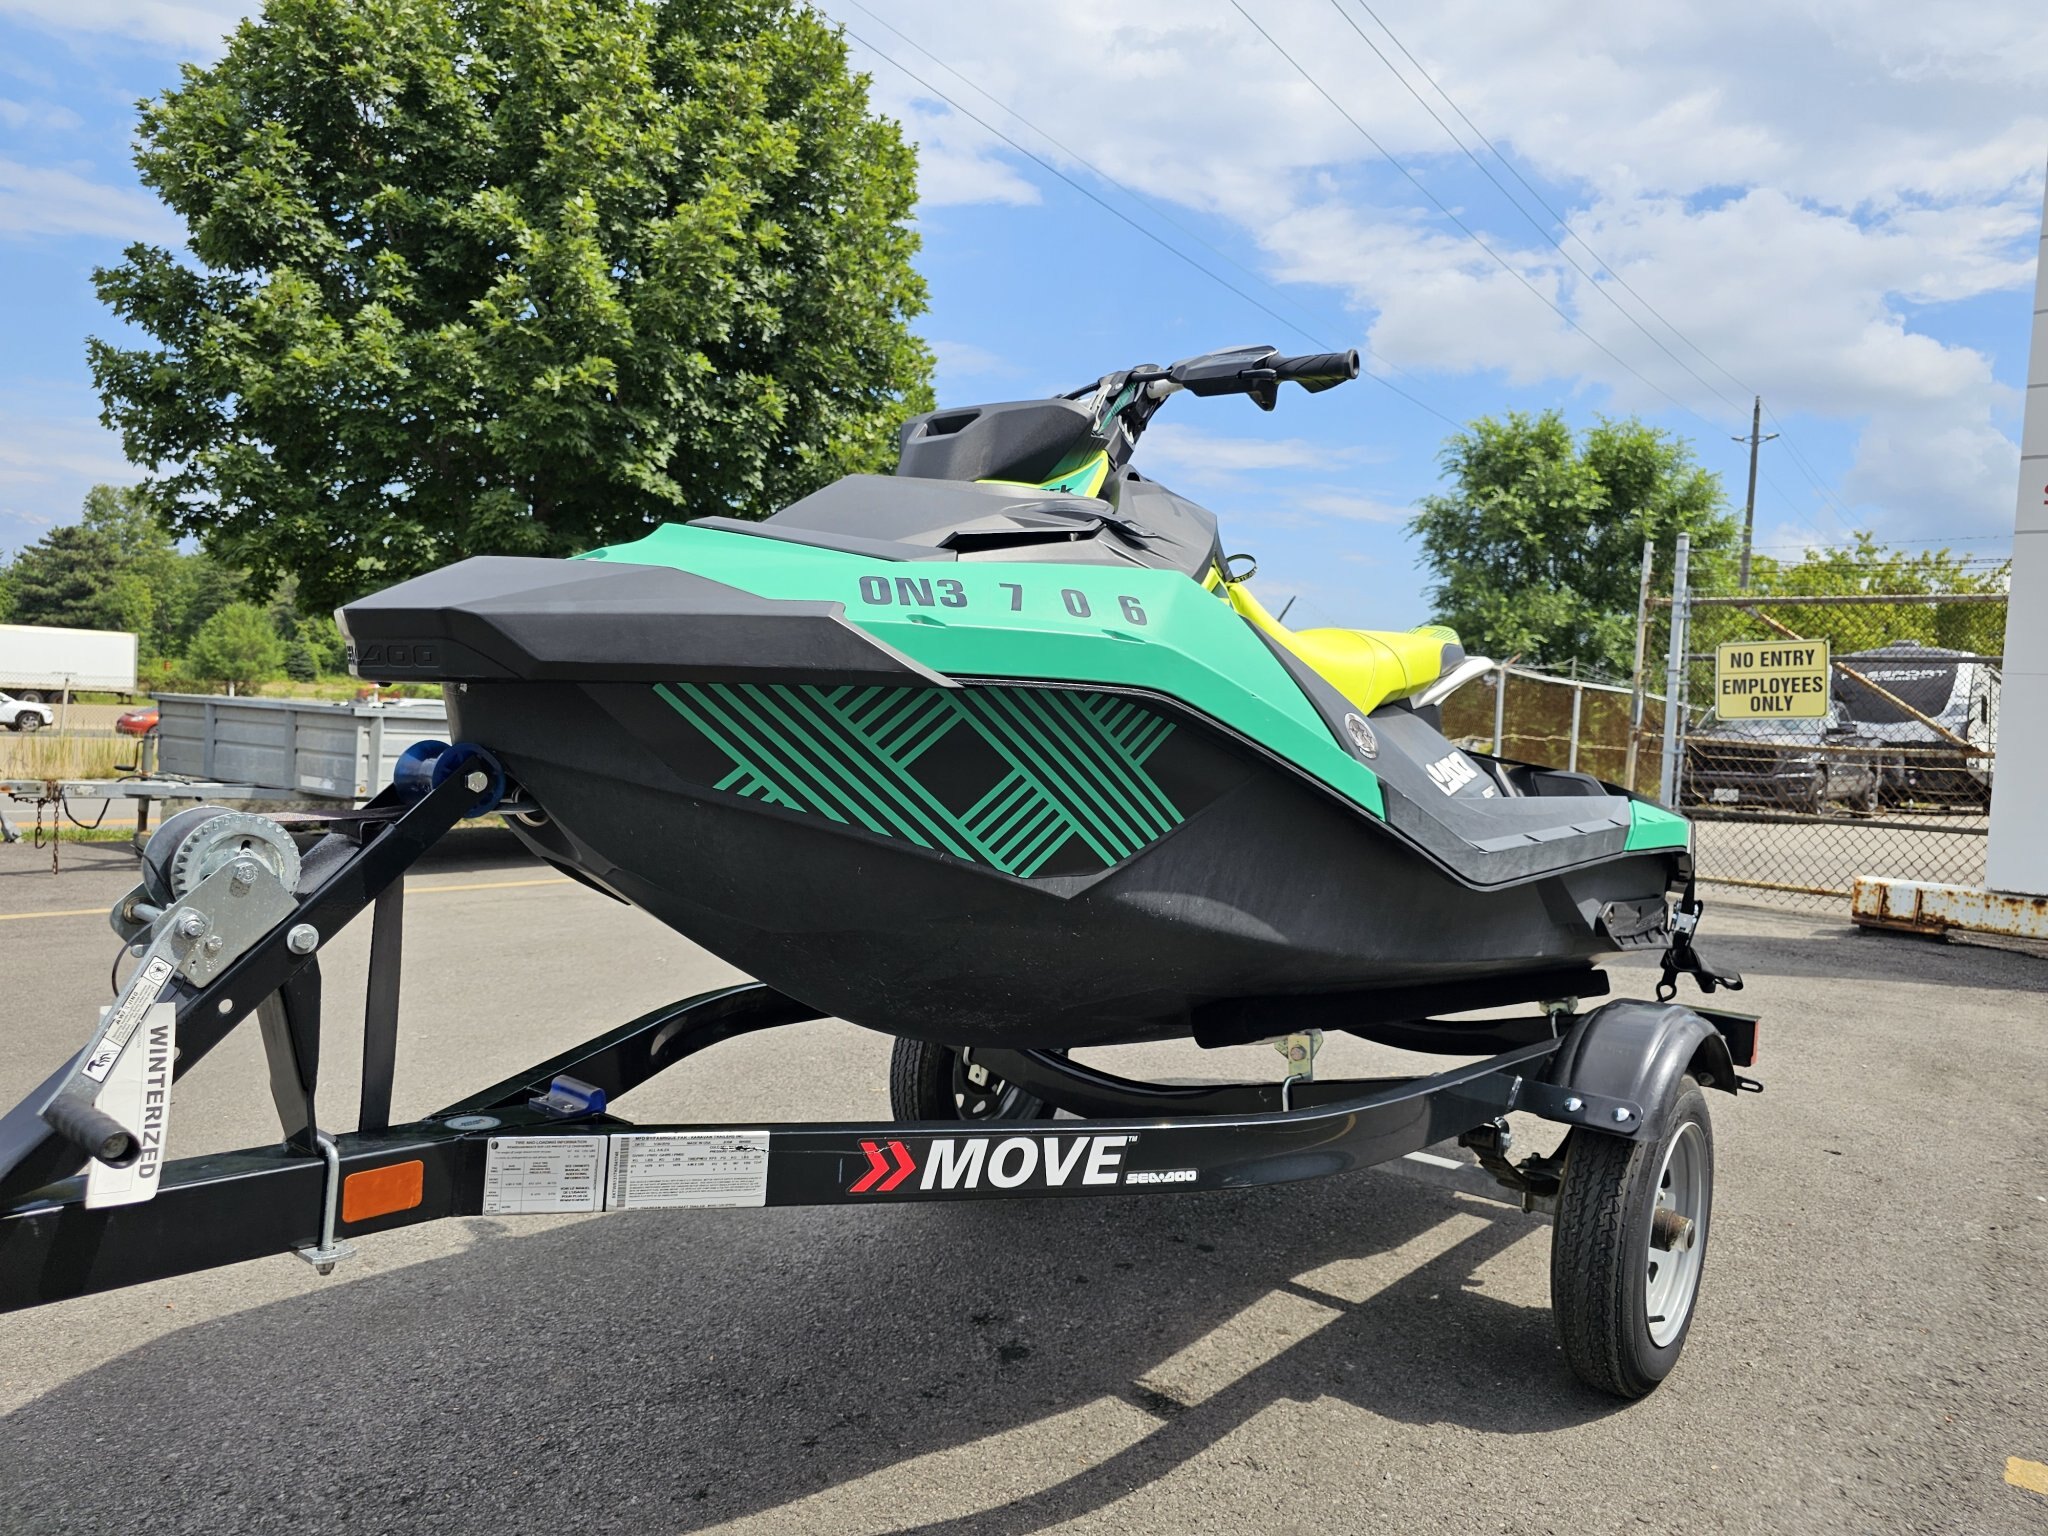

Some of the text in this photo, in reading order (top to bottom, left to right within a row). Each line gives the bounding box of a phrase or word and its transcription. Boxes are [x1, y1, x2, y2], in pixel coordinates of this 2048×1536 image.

[858, 575, 968, 608] ON3
[998, 582, 1023, 612] 7
[1117, 595, 1148, 626] 6
[1730, 649, 1815, 669] NO ENTRY
[1722, 676, 1823, 695] EMPLOYEES
[1750, 695, 1793, 712] ONLY
[138, 1024, 169, 1179] WINTERIZED
[919, 1136, 1128, 1190] MOVE
